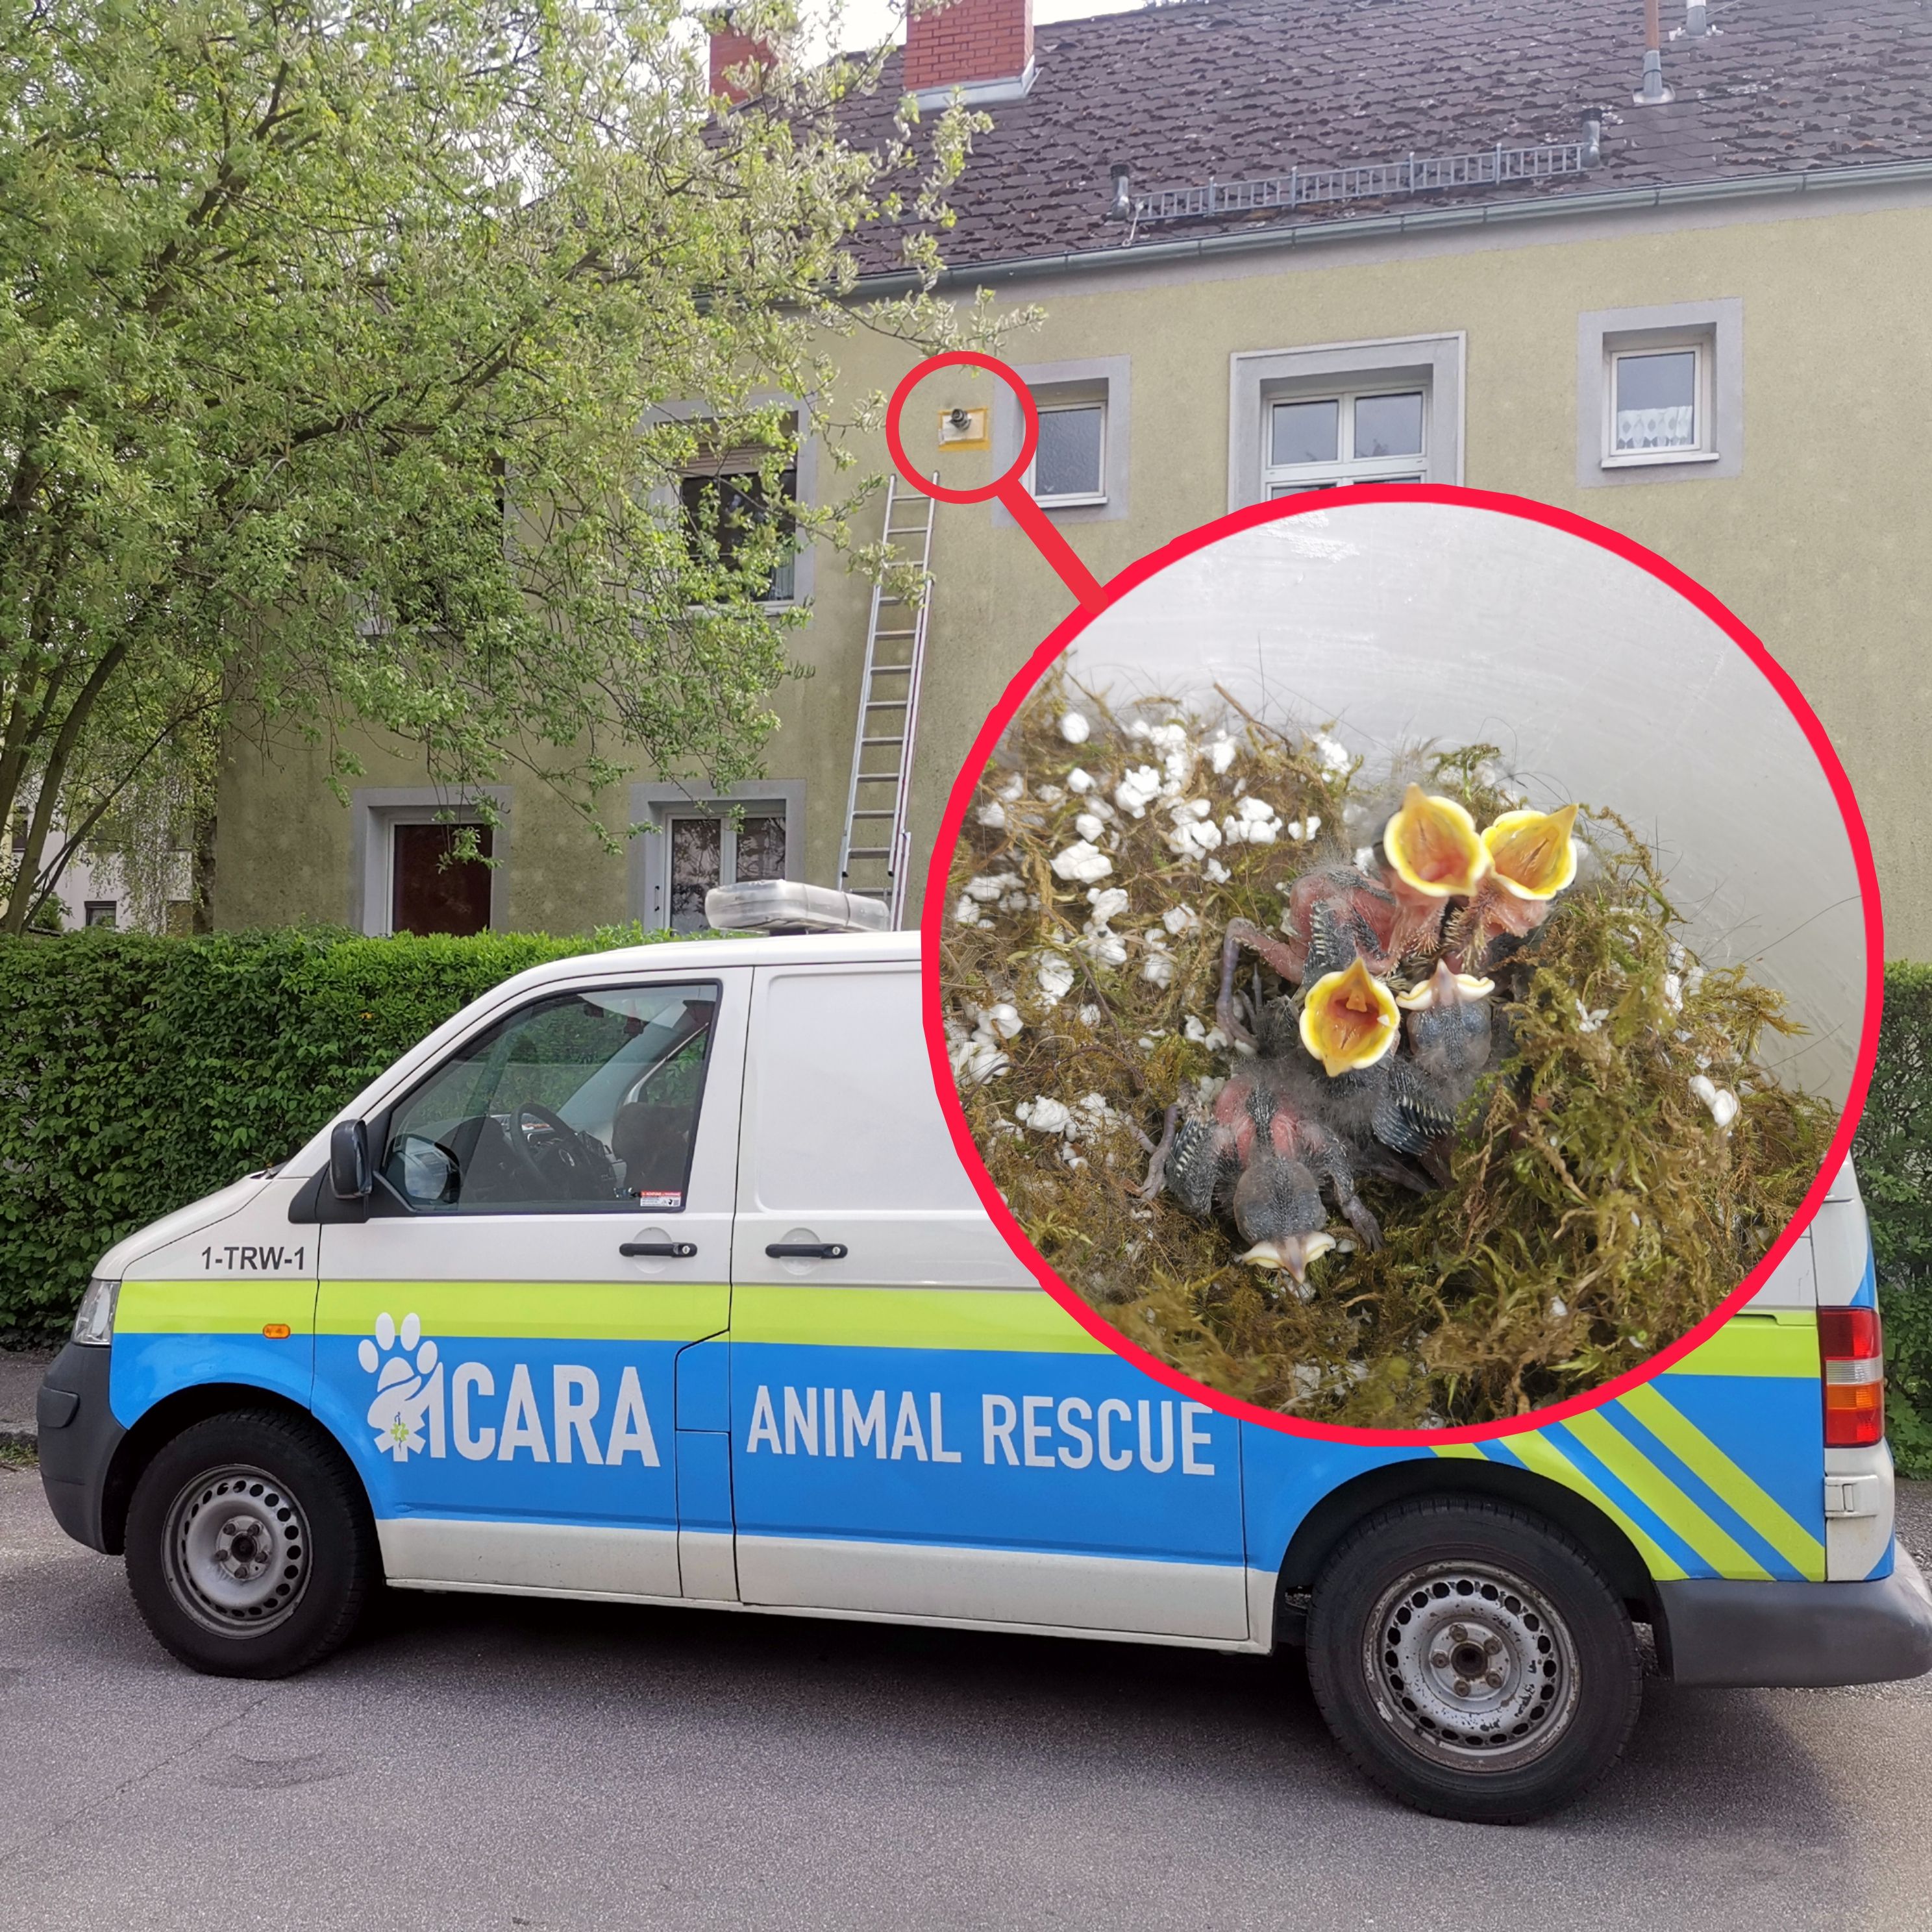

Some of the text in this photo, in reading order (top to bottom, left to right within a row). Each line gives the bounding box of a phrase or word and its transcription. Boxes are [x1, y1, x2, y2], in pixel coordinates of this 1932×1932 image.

[202, 1246, 304, 1270] 1-TRW-1
[746, 1385, 962, 1463] ANIMAL
[982, 1394, 1215, 1476] RESCUE
